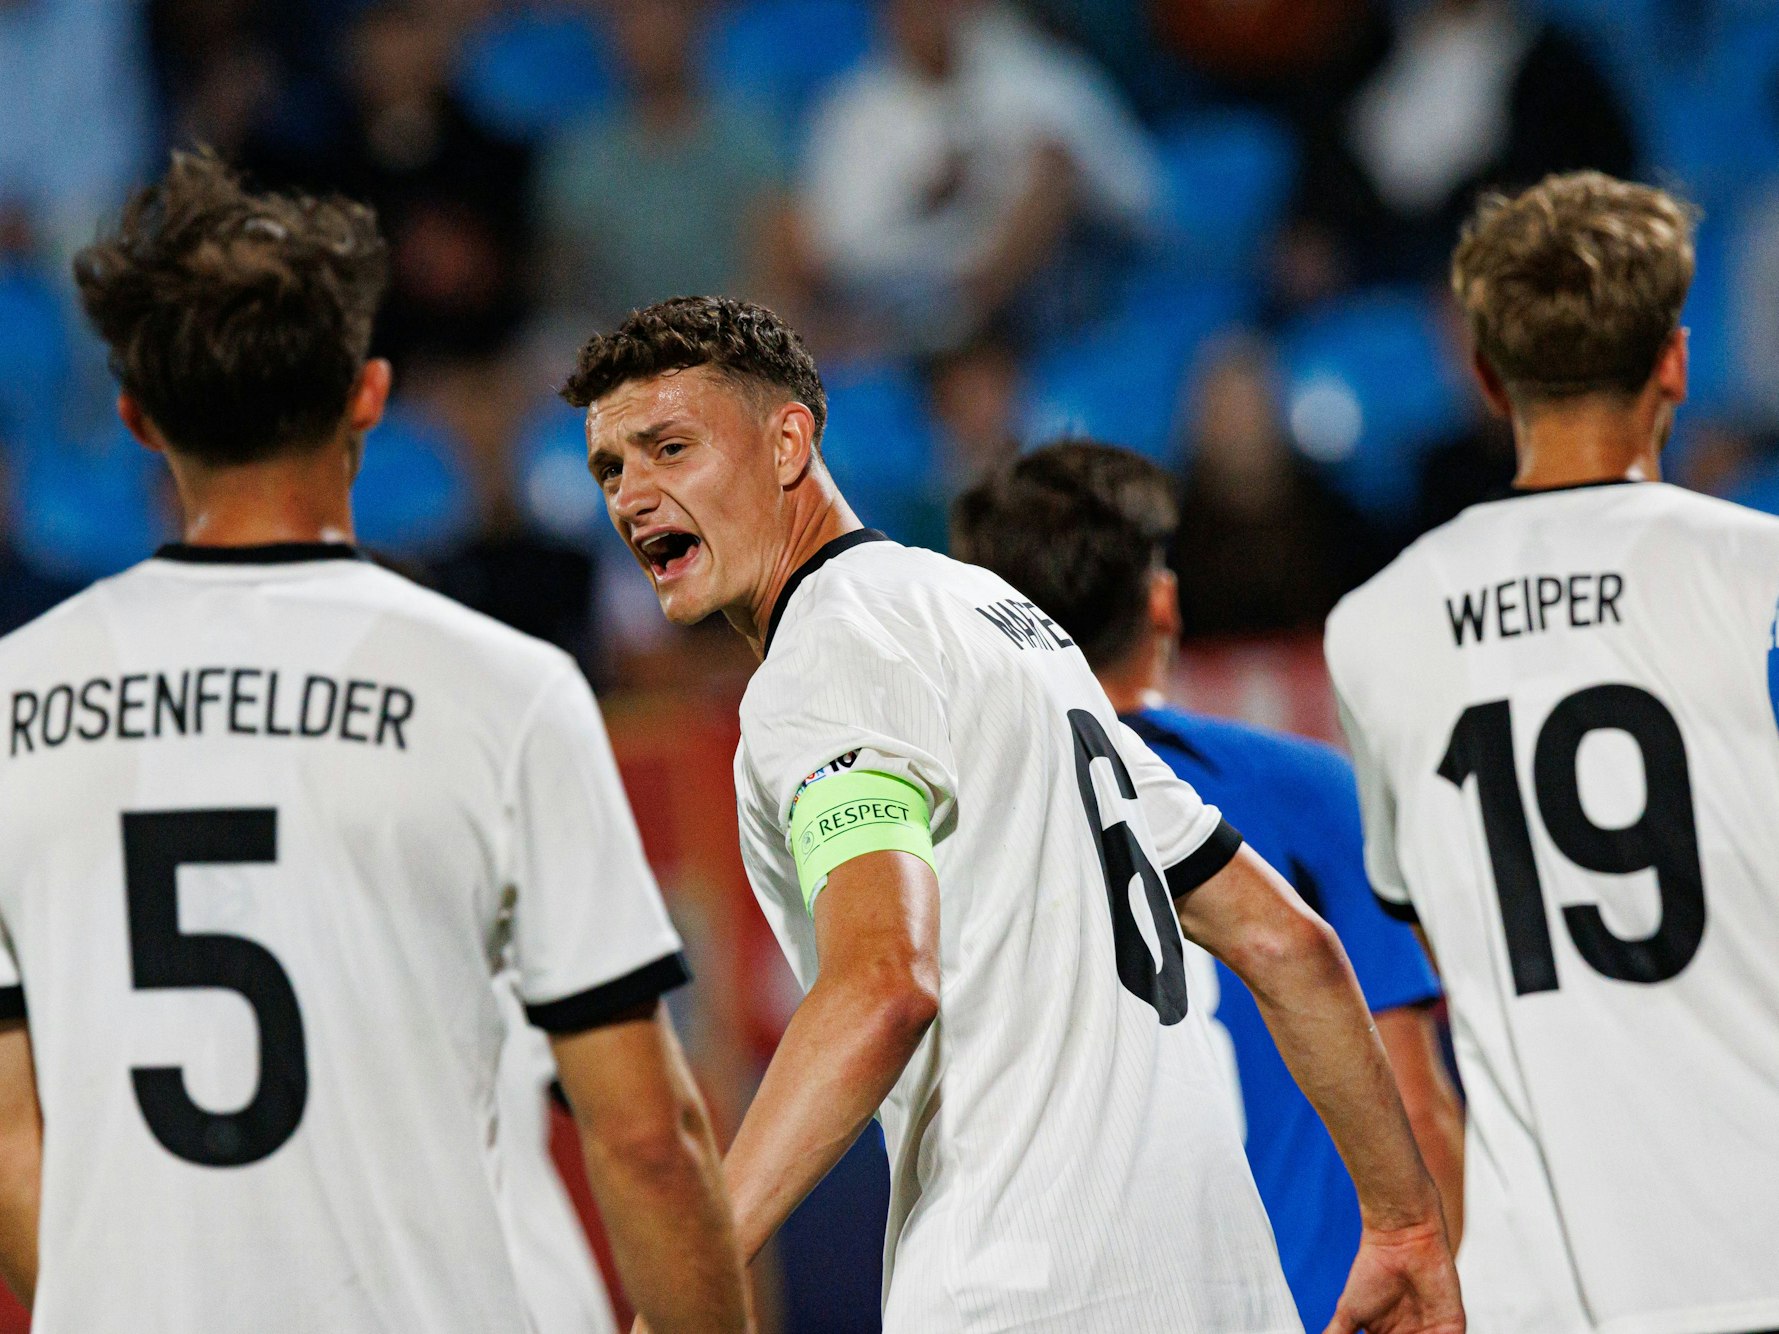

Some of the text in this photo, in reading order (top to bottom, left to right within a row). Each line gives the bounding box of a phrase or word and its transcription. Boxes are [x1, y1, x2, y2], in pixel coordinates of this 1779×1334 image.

[1446, 573, 1624, 647] WEIPER
[9, 667, 415, 757] ROSENFELDER
[818, 803, 910, 836] RESPECT
[1067, 708, 1188, 1026] 6
[1436, 683, 1708, 997] 19
[120, 807, 309, 1169] 5
